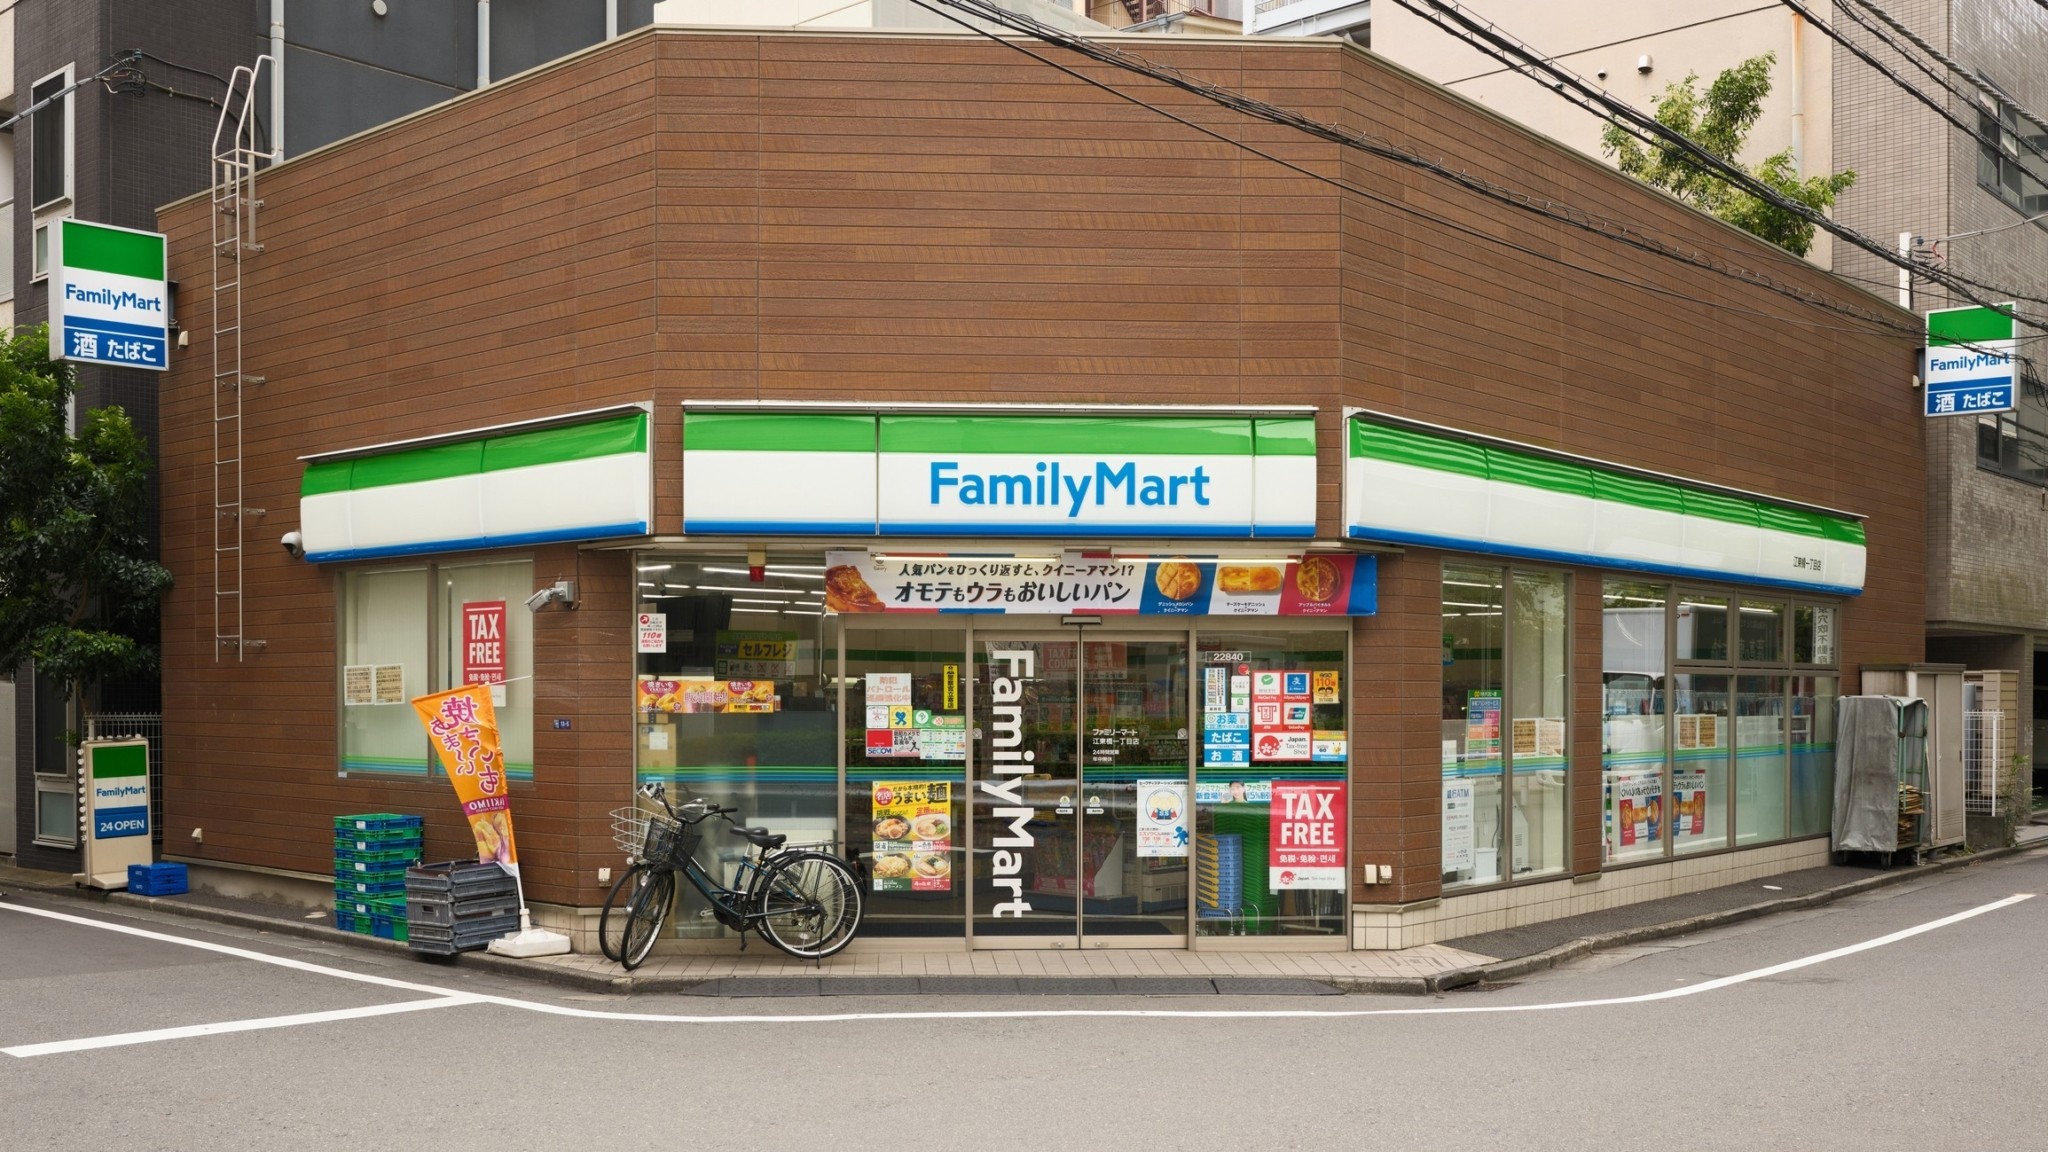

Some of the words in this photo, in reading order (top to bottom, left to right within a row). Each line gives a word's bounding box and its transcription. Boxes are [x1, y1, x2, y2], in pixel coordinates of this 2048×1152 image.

[65, 284, 161, 312] FamilyMart
[73, 331, 98, 359] 酒
[107, 338, 157, 363] たばこ
[1930, 353, 2010, 371] FamilyMart
[1935, 393, 1955, 412] 酒
[1963, 391, 2004, 408] たばこ
[930, 462, 1210, 517] FamilyMart
[895, 581, 1131, 603] オモテもウラもおいしいパン
[469, 613, 500, 640] TAX
[469, 642, 501, 664] FREE
[743, 641, 792, 657] セルフレジ
[1048, 648, 1065, 658] TAX
[1067, 648, 1089, 658] FRE
[1213, 653, 1243, 661] 22840
[1048, 658, 1089, 669] COUNTR
[866, 685, 911, 693] パトロール
[1216, 714, 1237, 724] お薬
[1092, 728, 1138, 736] ファミリーマート
[1092, 737, 1140, 745] 江東橋一丁目店
[1211, 732, 1243, 743] たばこ
[96, 785, 146, 797] FamilyMart
[981, 650, 1035, 918] FamilyMart
[893, 783, 948, 805] うまい麺
[1281, 793, 1335, 820] TAX
[100, 822, 114, 832] 24
[114, 819, 145, 831] OPEN
[1281, 822, 1335, 845] FREE
